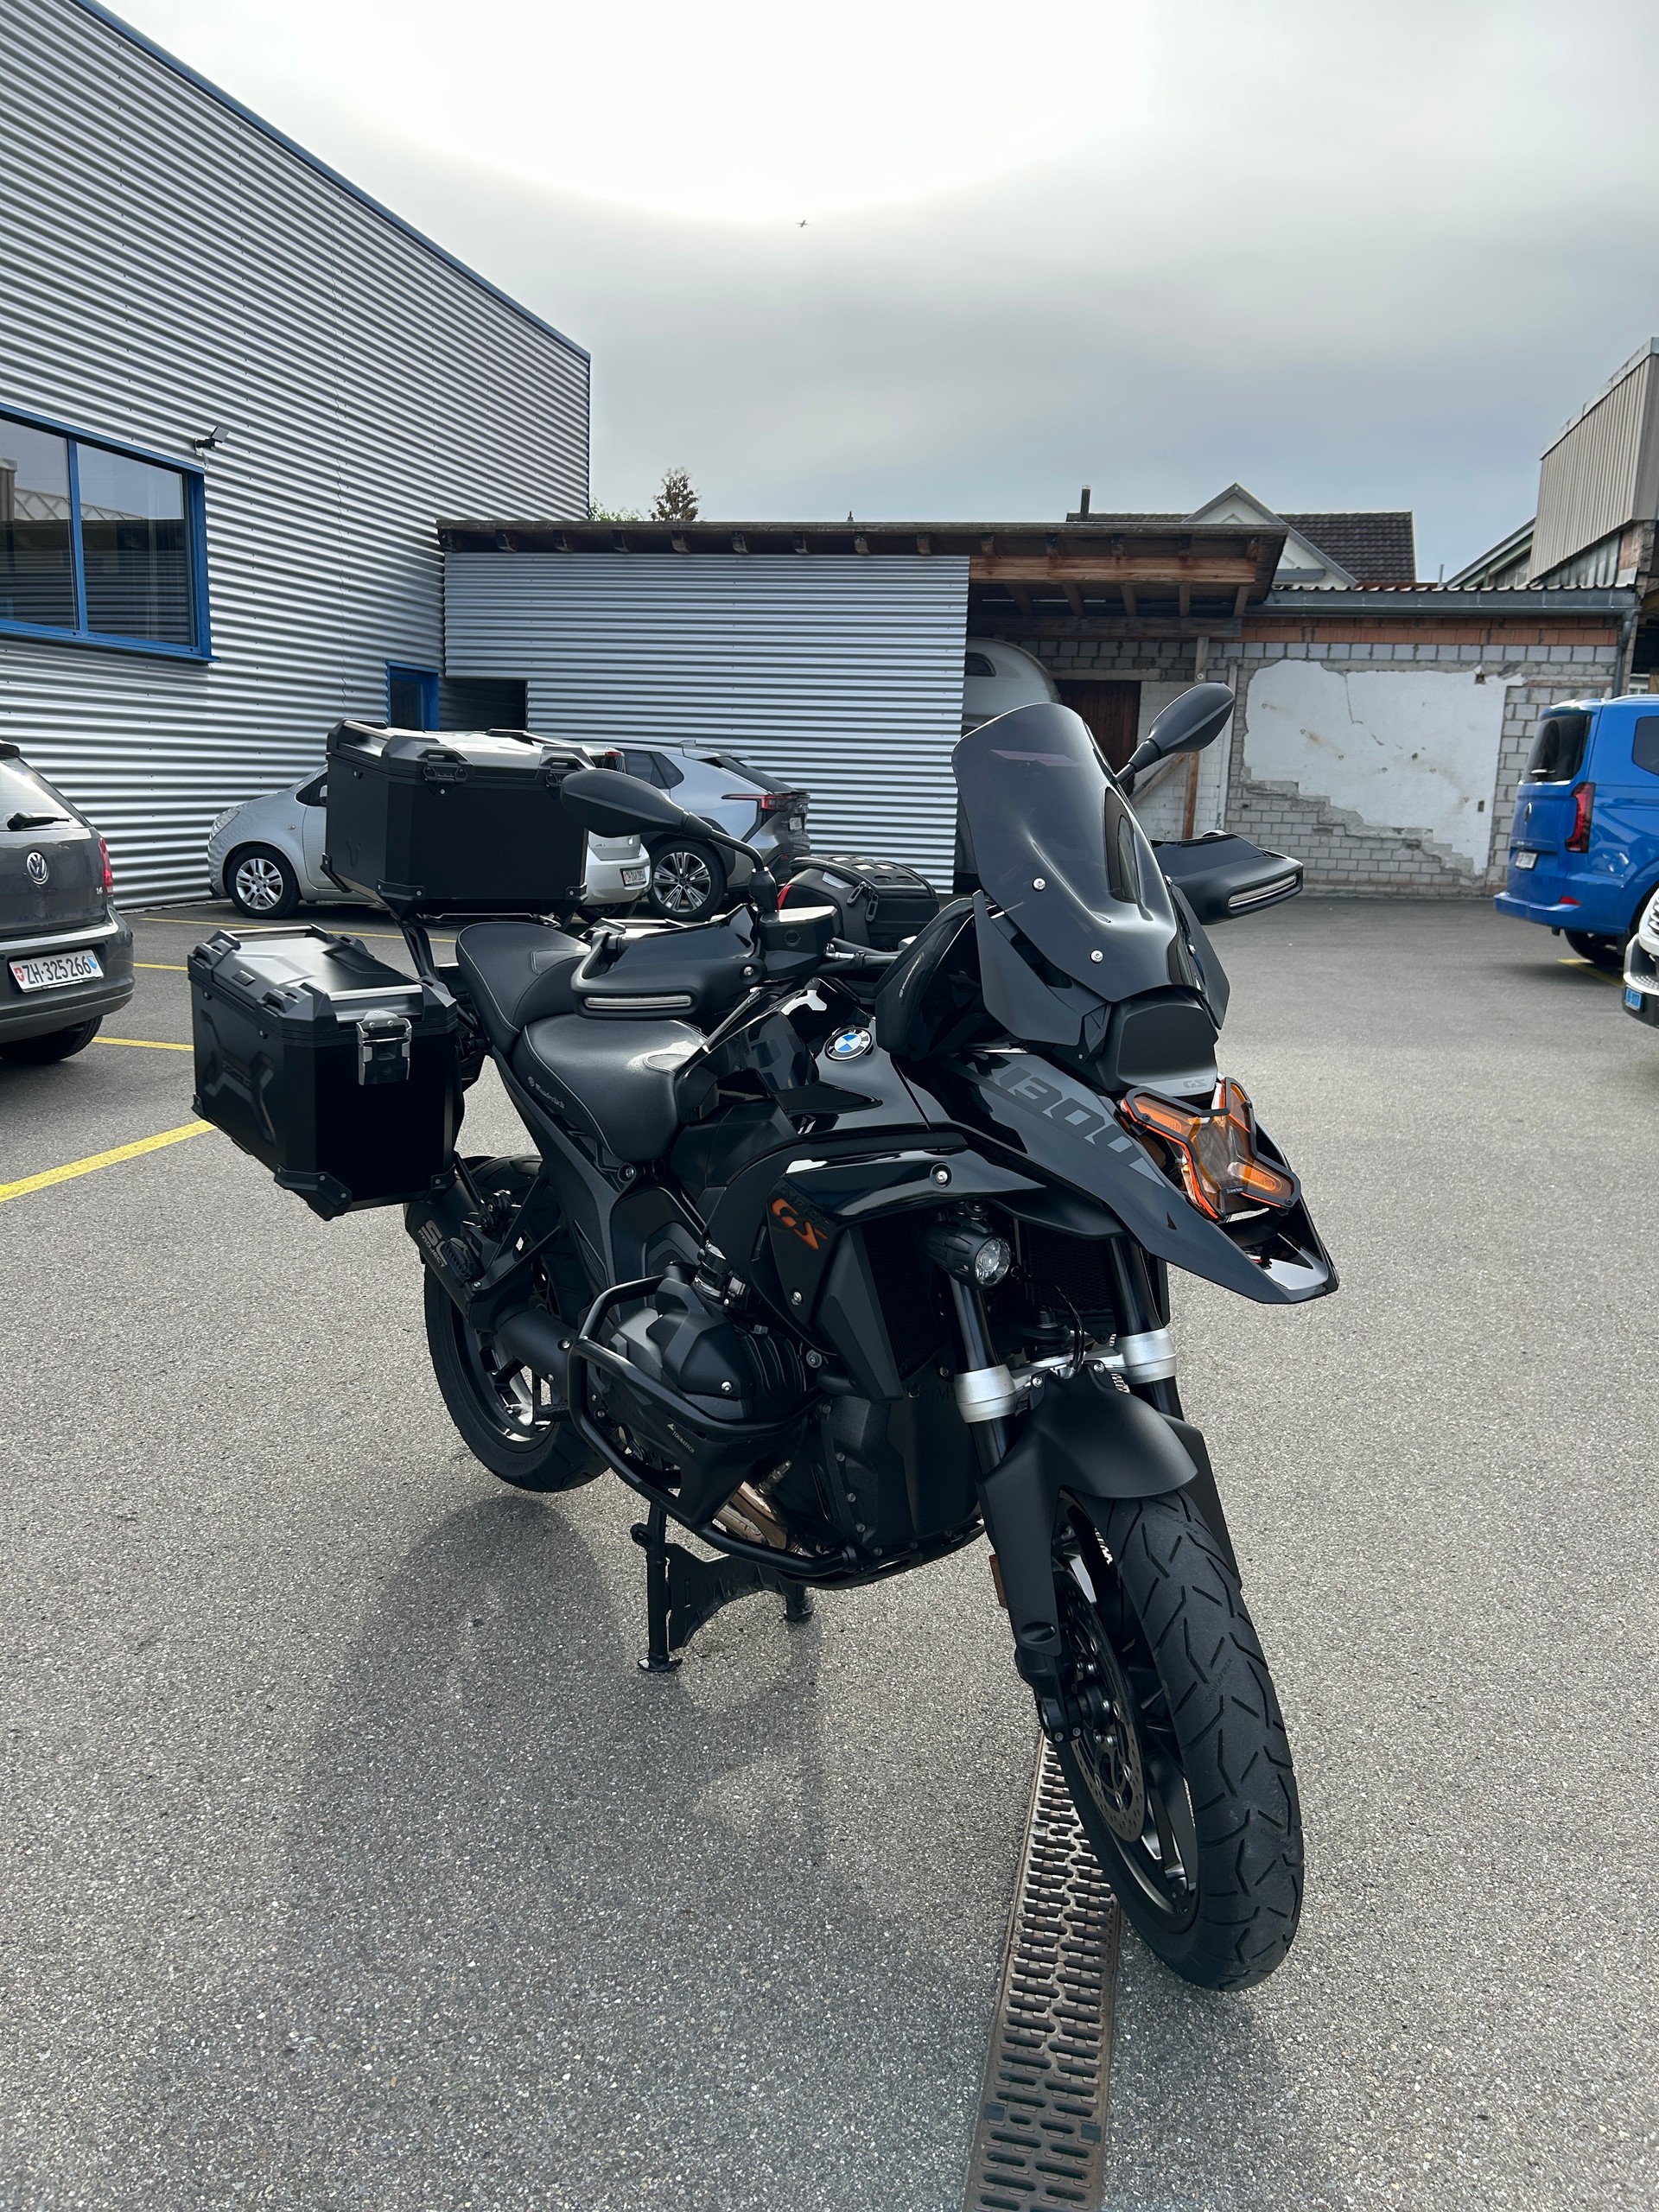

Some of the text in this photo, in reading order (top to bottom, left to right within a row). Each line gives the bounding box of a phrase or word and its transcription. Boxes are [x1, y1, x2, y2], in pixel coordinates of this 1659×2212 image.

[770, 1198, 830, 1250] GS
[417, 1229, 446, 1268] PROJECT
[671, 1430, 696, 1453] TOURATECH
